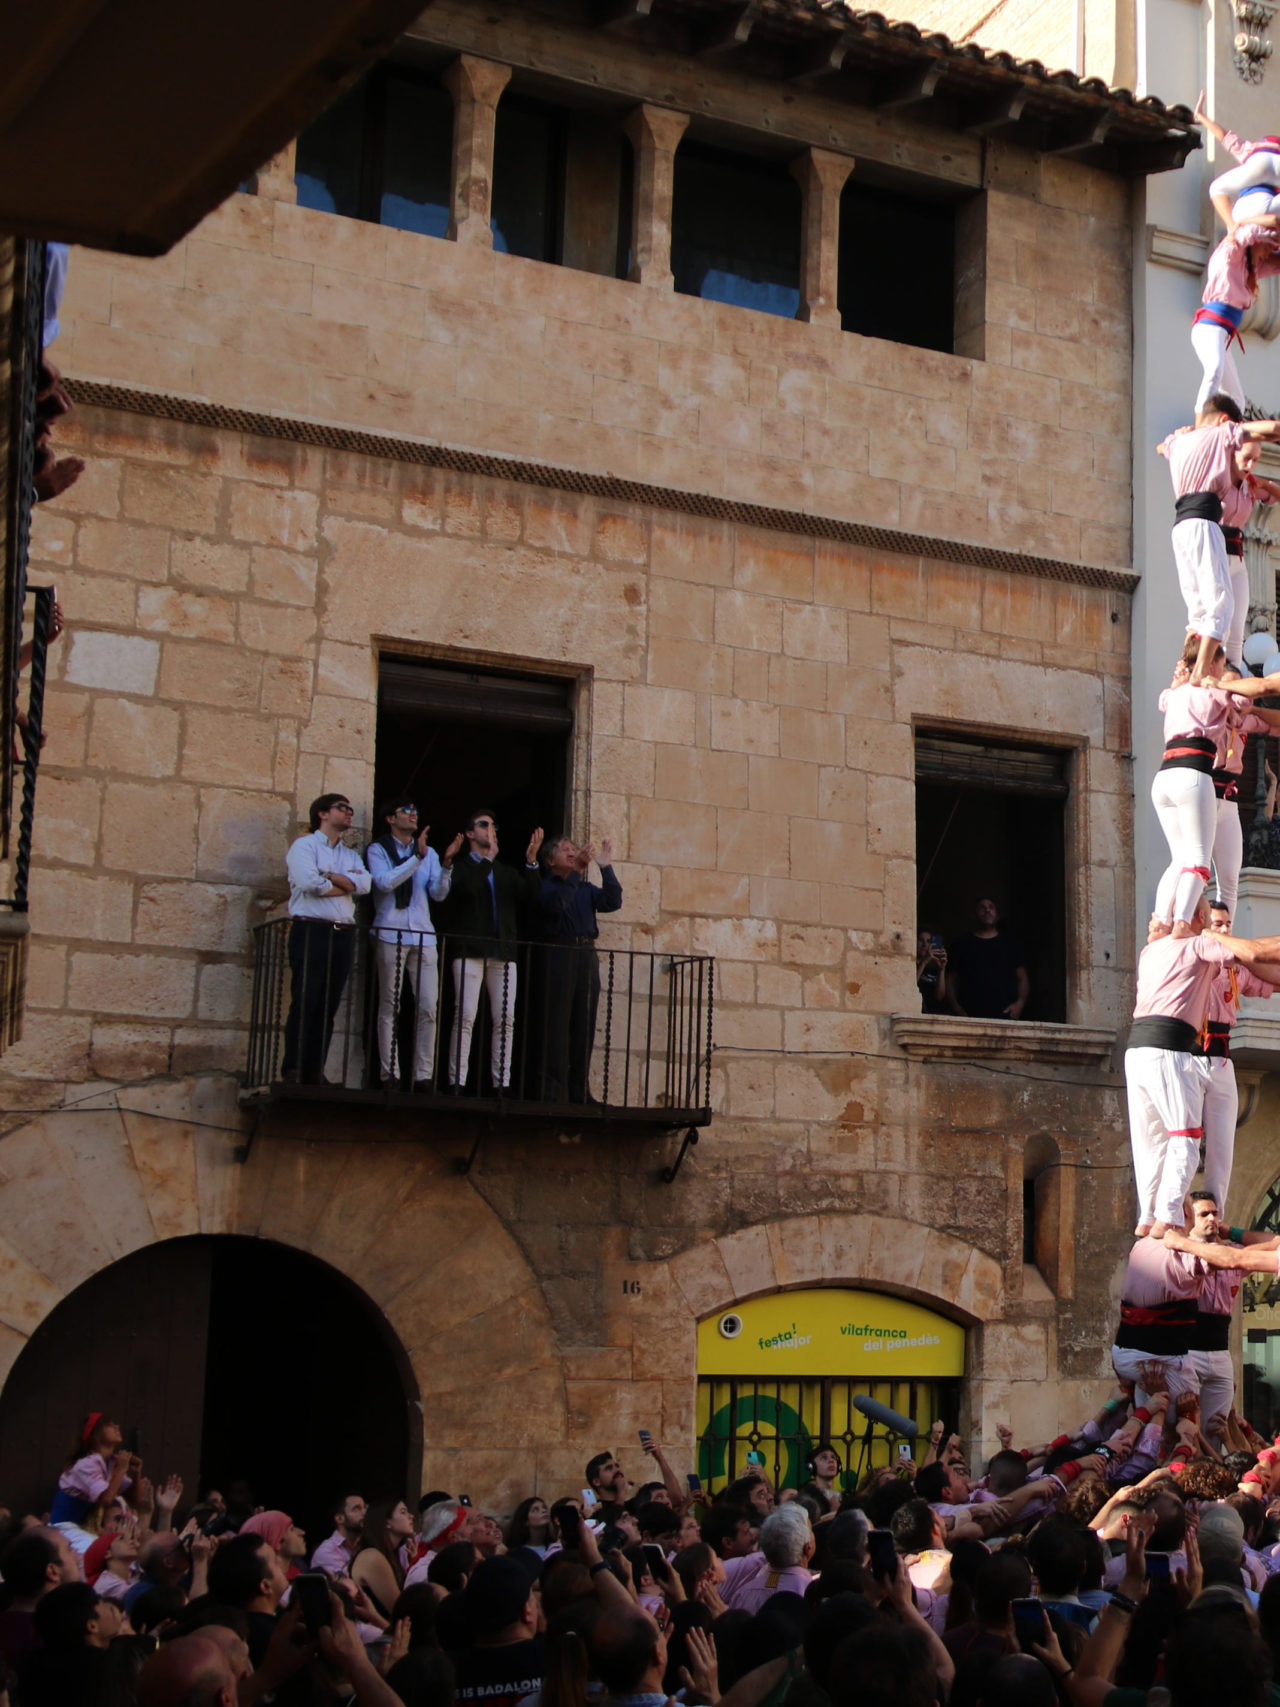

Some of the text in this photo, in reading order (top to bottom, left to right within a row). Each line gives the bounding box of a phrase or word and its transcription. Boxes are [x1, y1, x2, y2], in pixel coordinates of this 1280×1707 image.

[623, 1280, 641, 1295] 16
[758, 1323, 797, 1350] festa!
[840, 1323, 907, 1339] vilafranca
[772, 1335, 812, 1350] major
[863, 1333, 940, 1352] del penedès
[477, 1678, 542, 1698] BADALON
